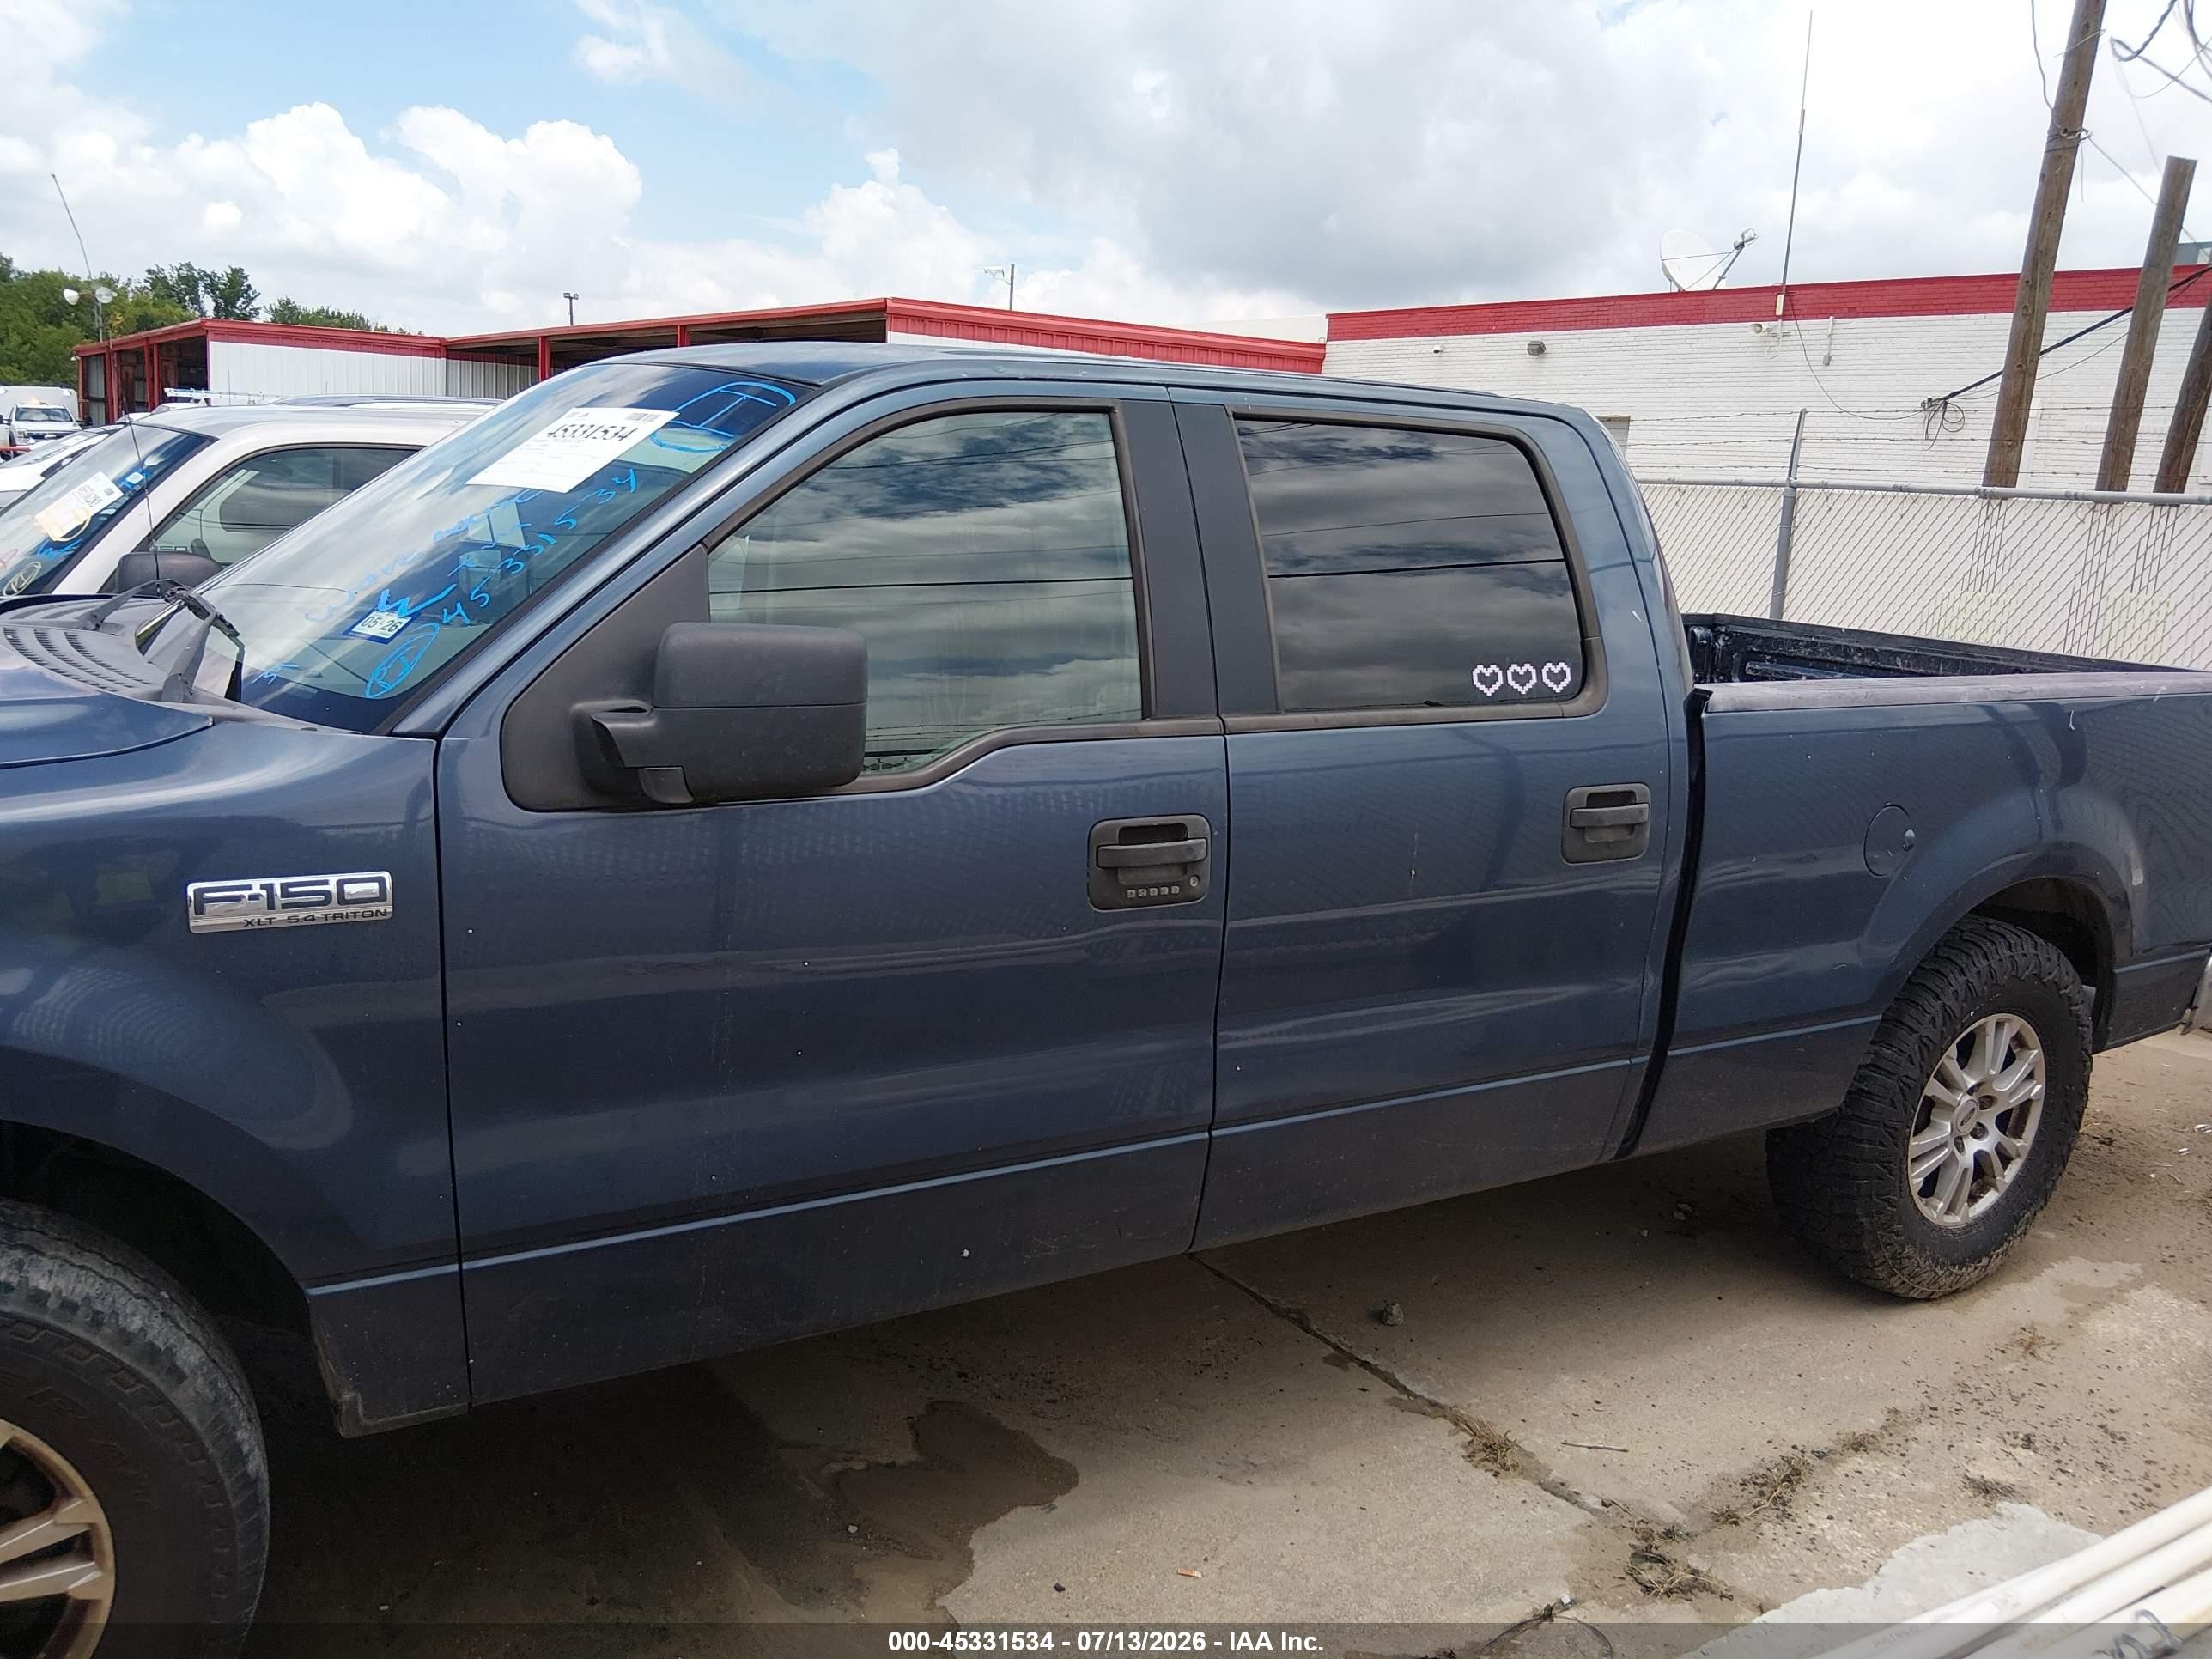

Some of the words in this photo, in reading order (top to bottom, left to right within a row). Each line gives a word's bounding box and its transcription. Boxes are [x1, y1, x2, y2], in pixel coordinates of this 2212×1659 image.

[547, 423, 640, 441] 45331534
[361, 616, 383, 629] 05
[380, 619, 403, 633] 26
[243, 916, 276, 927] XLT
[287, 915, 317, 925] 5.4
[321, 908, 387, 921] TRITON
